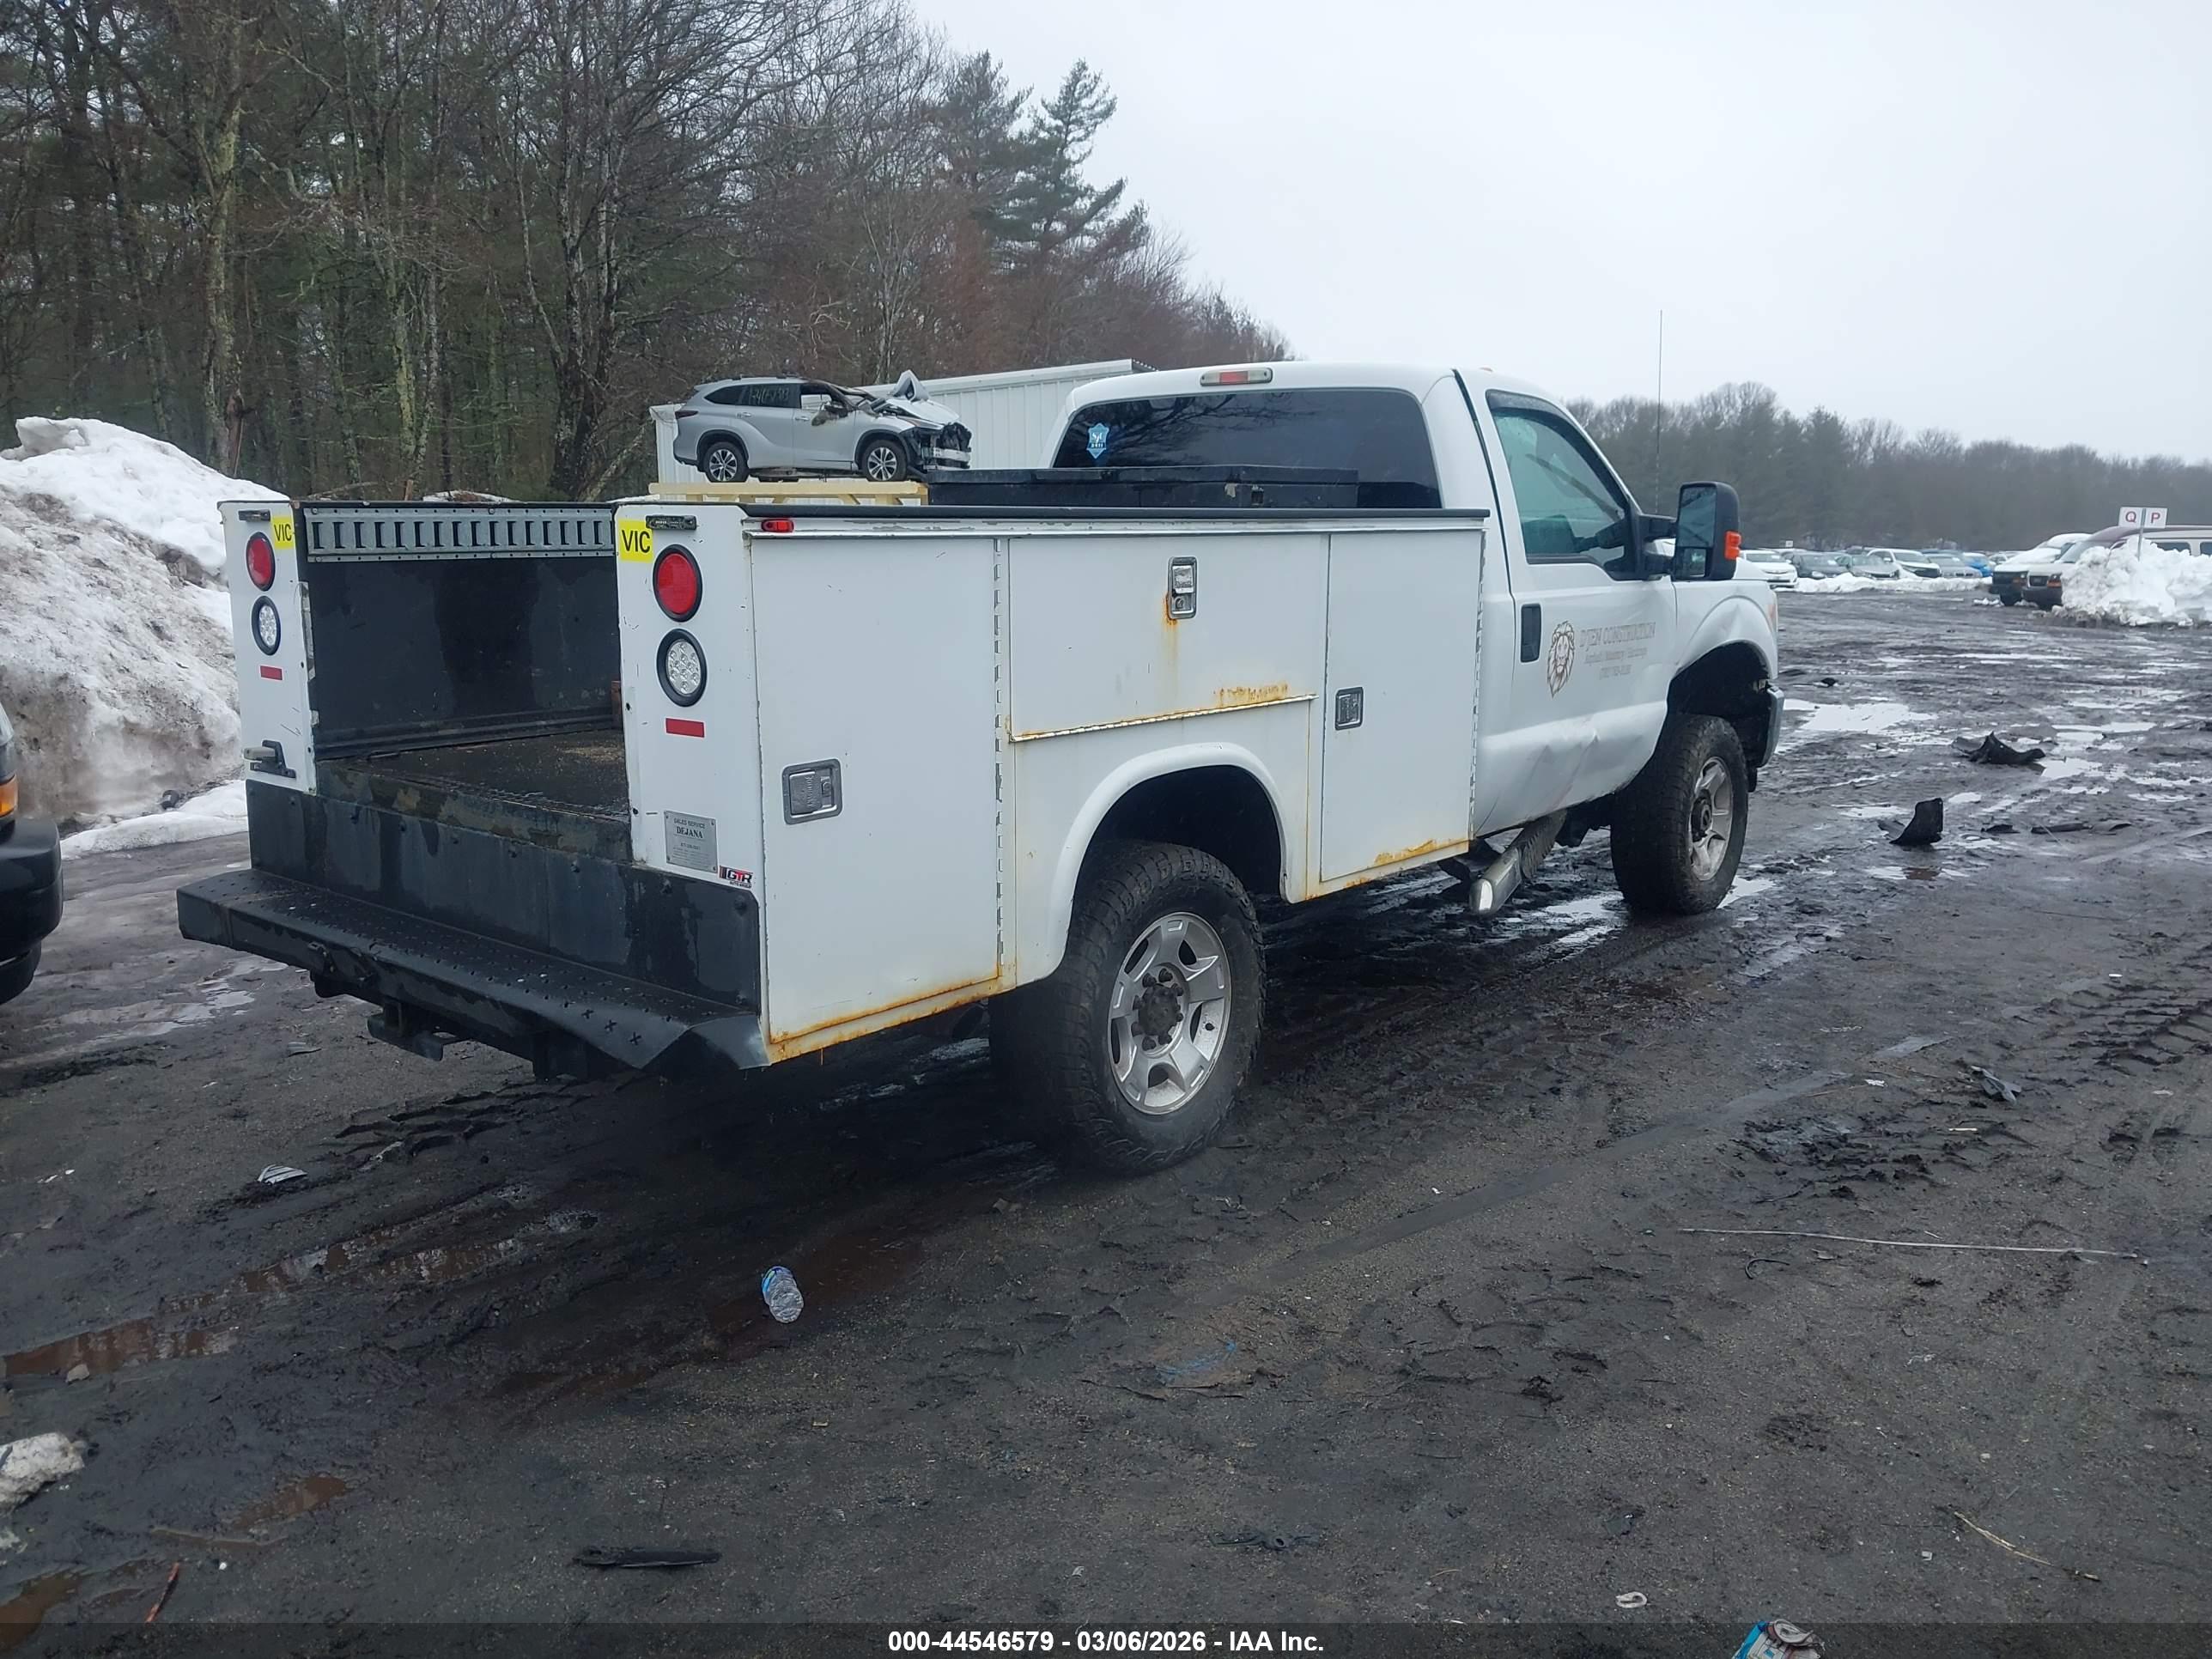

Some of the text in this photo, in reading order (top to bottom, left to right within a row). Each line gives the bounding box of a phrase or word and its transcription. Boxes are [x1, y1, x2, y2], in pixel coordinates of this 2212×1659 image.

[2125, 511, 2136, 523] Q
[2150, 512, 2160, 524] P
[274, 524, 292, 542] VIC
[622, 529, 651, 553] VIC
[676, 826, 703, 839] DEJANA
[726, 868, 752, 884] GTR
